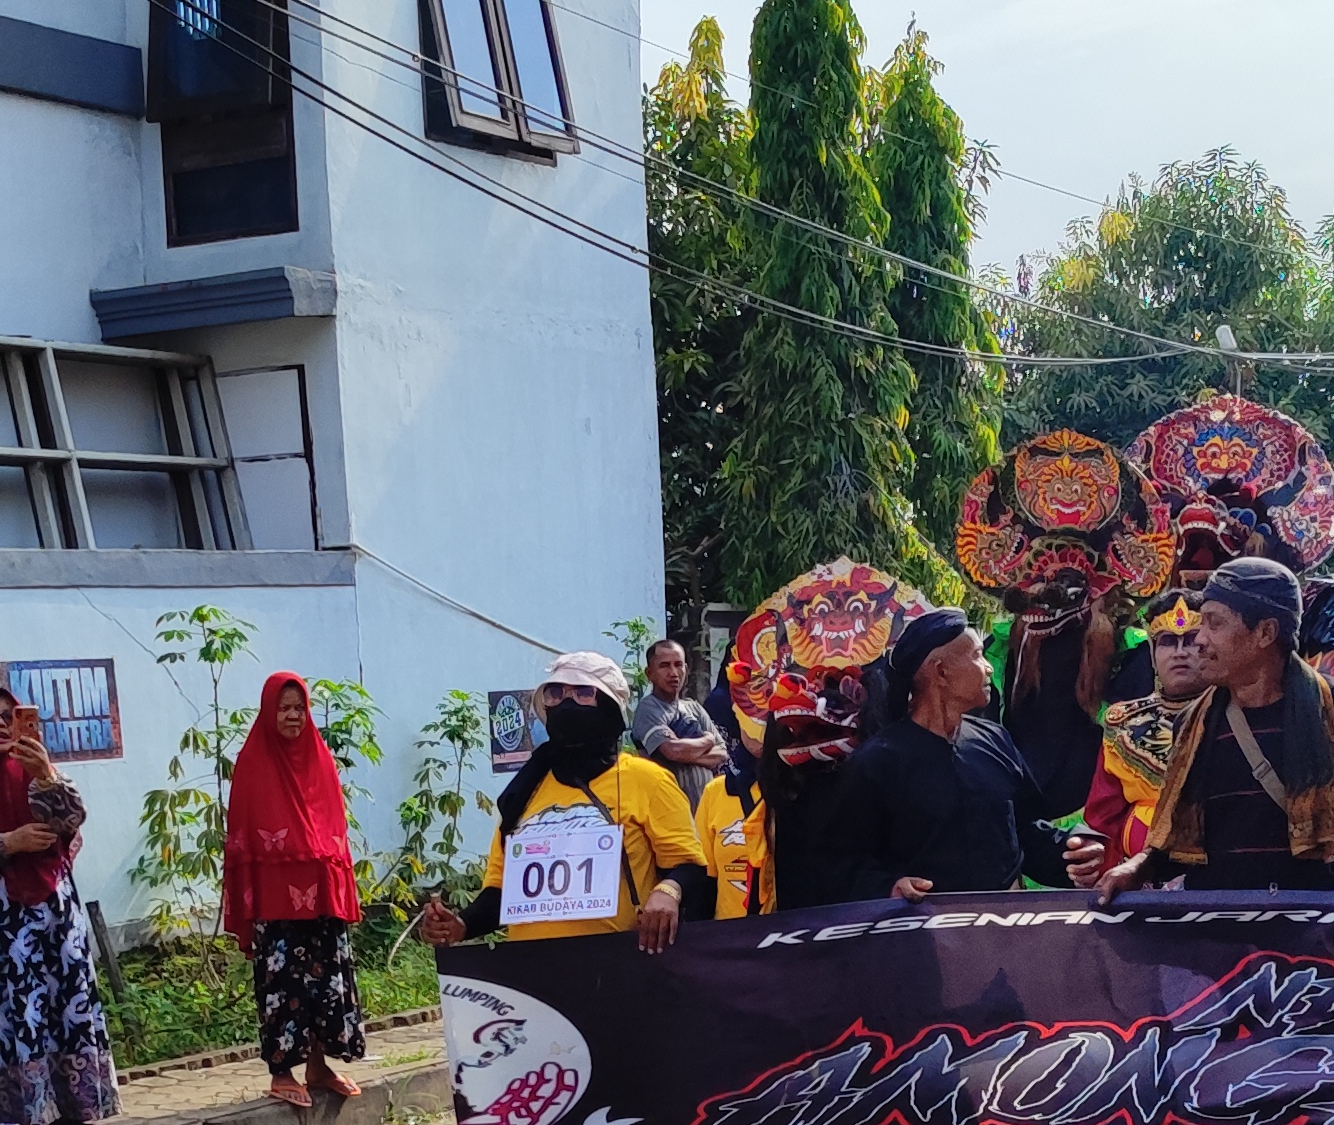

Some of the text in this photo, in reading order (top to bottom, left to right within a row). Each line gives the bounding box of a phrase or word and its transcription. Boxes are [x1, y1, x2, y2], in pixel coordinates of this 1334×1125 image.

[9, 667, 111, 719] KUTIM
[495, 711, 522, 736] 2024
[522, 857, 593, 898] 001
[506, 899, 612, 916] KIRAB BUDAYA 2024
[756, 910, 1134, 949] KESENIAN
[442, 982, 515, 1016] LUMPING
